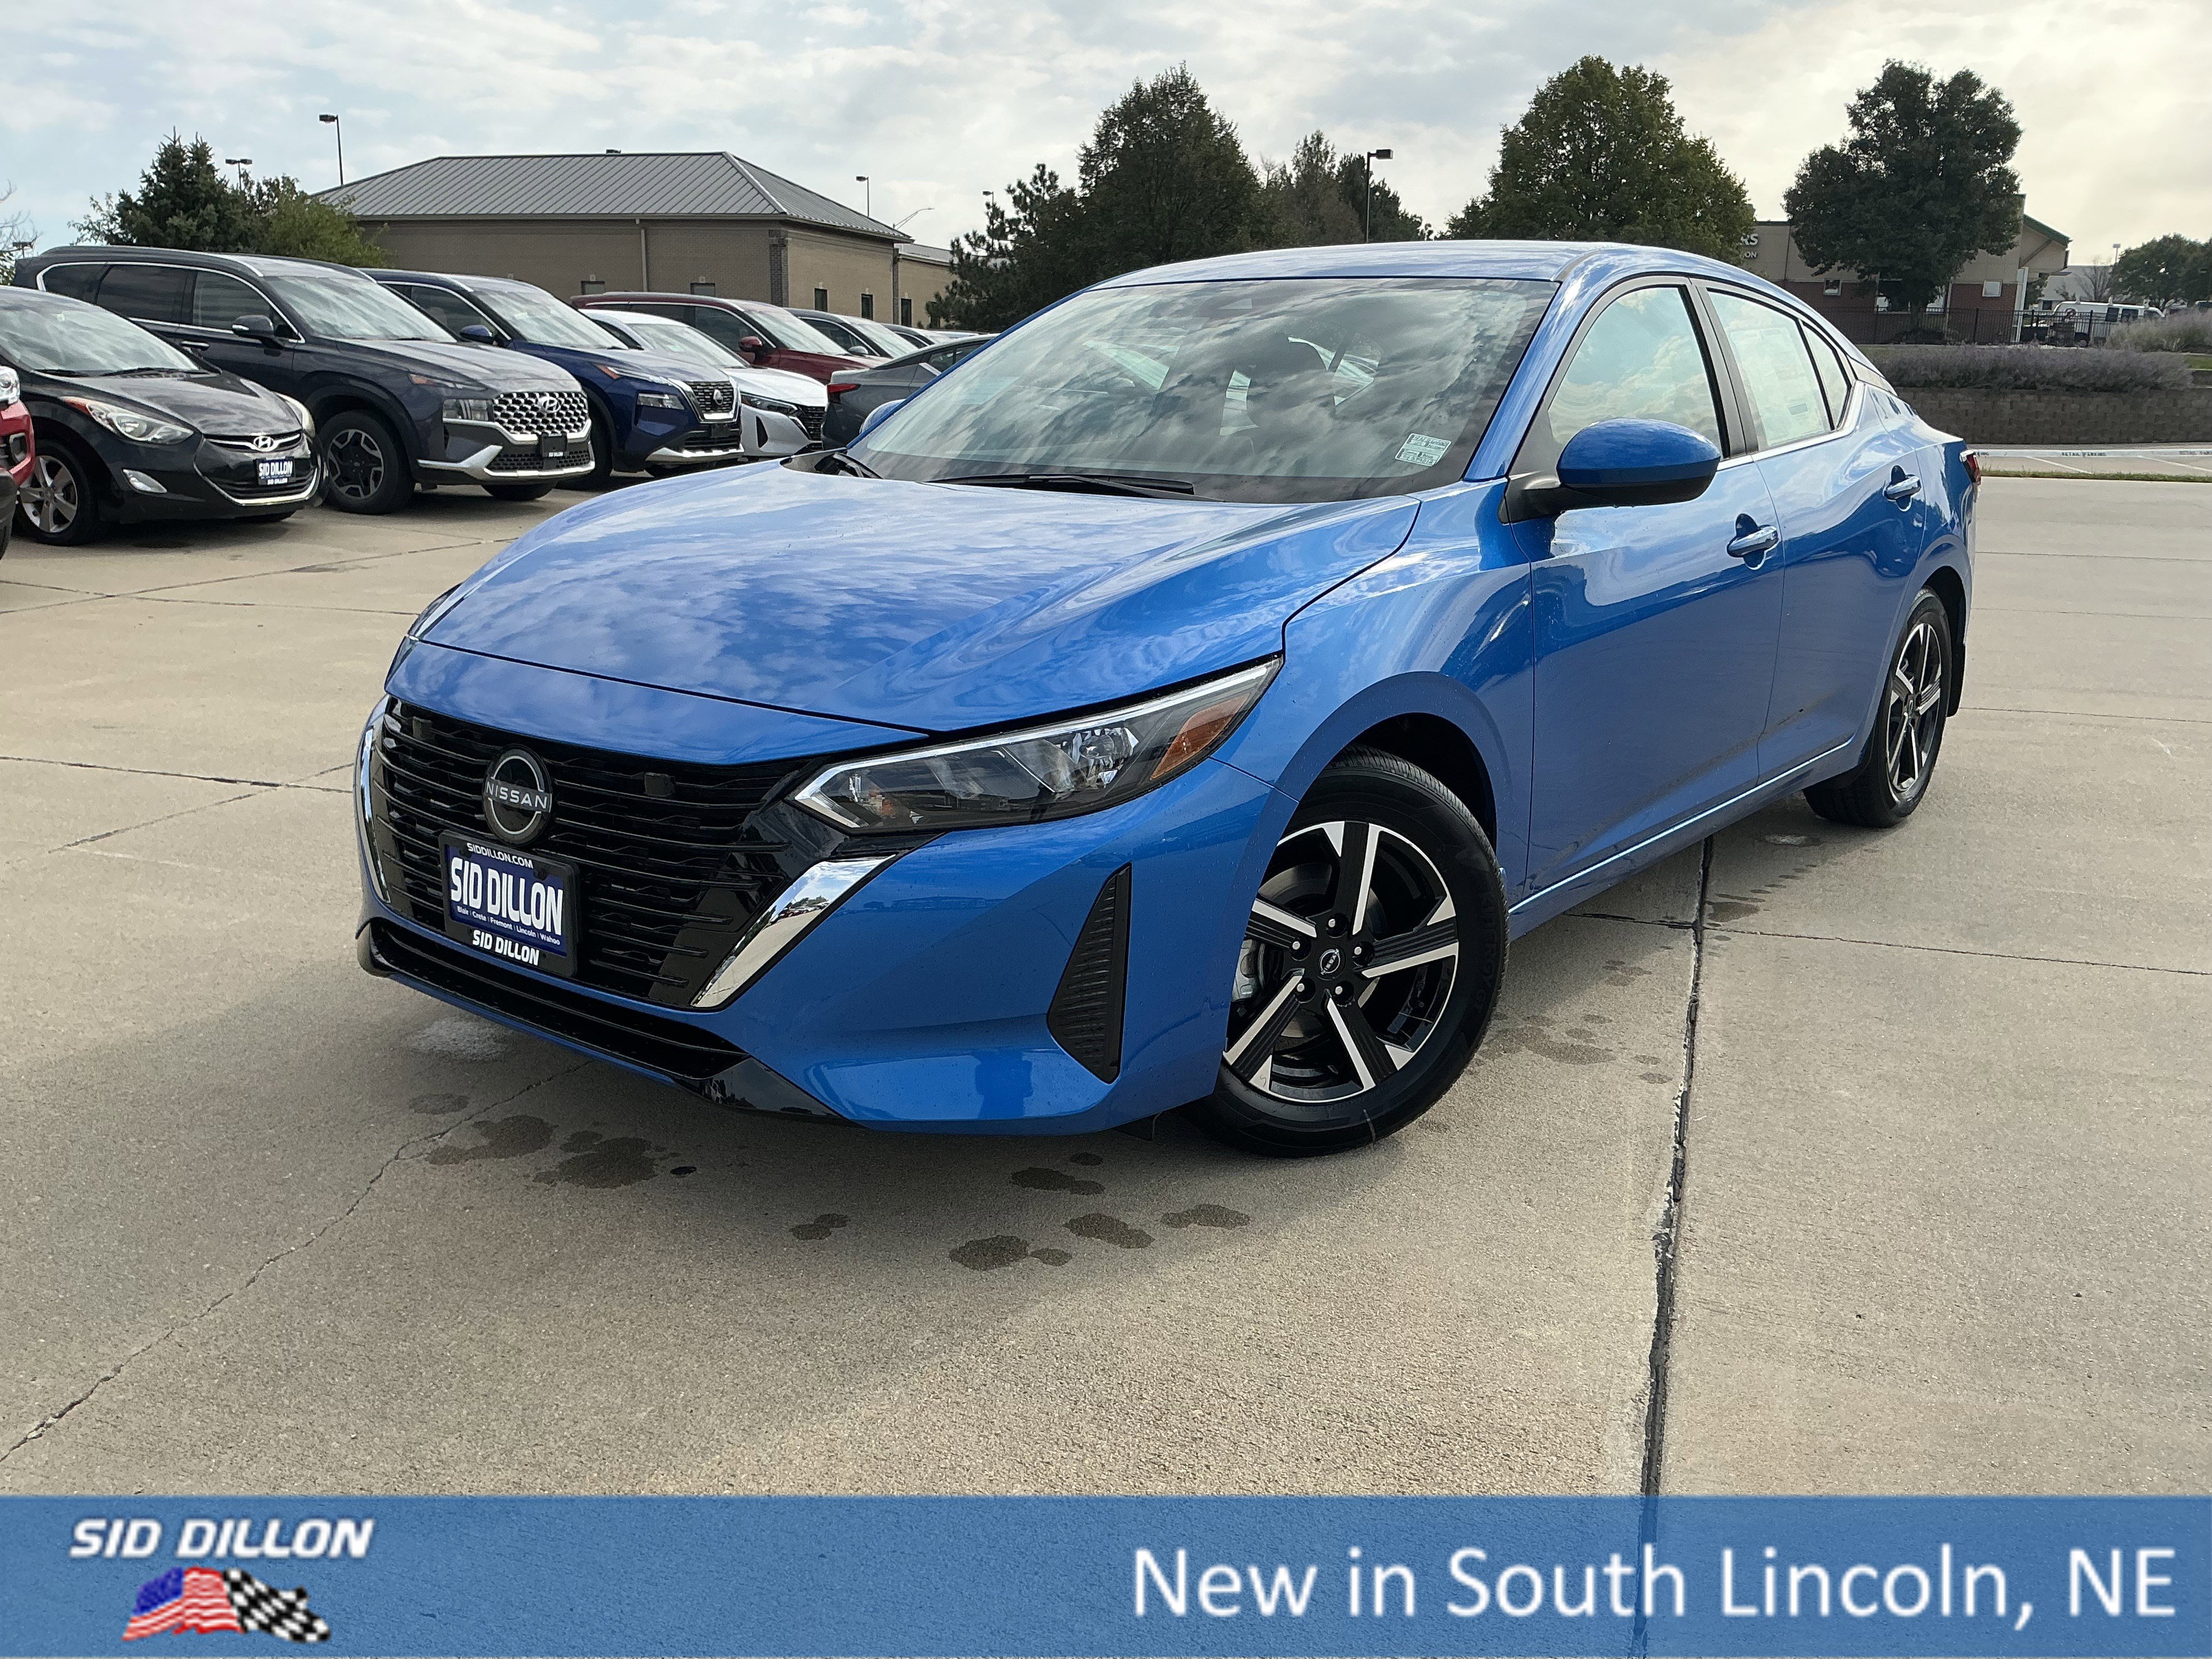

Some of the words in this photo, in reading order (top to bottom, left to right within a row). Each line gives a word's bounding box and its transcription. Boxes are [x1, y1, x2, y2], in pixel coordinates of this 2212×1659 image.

[259, 462, 270, 477] SID
[270, 461, 293, 476] DILLON
[486, 781, 548, 809] NISSAN
[466, 842, 534, 869] SIDDILLON.COM
[450, 856, 483, 909] SID
[487, 868, 563, 935] DILLON
[456, 905, 469, 916] Blair
[490, 916, 513, 930] Fremont
[516, 925, 537, 938] Lincoln
[539, 933, 561, 945] Wahoo
[472, 929, 493, 950] SID
[494, 936, 540, 966] DILLON
